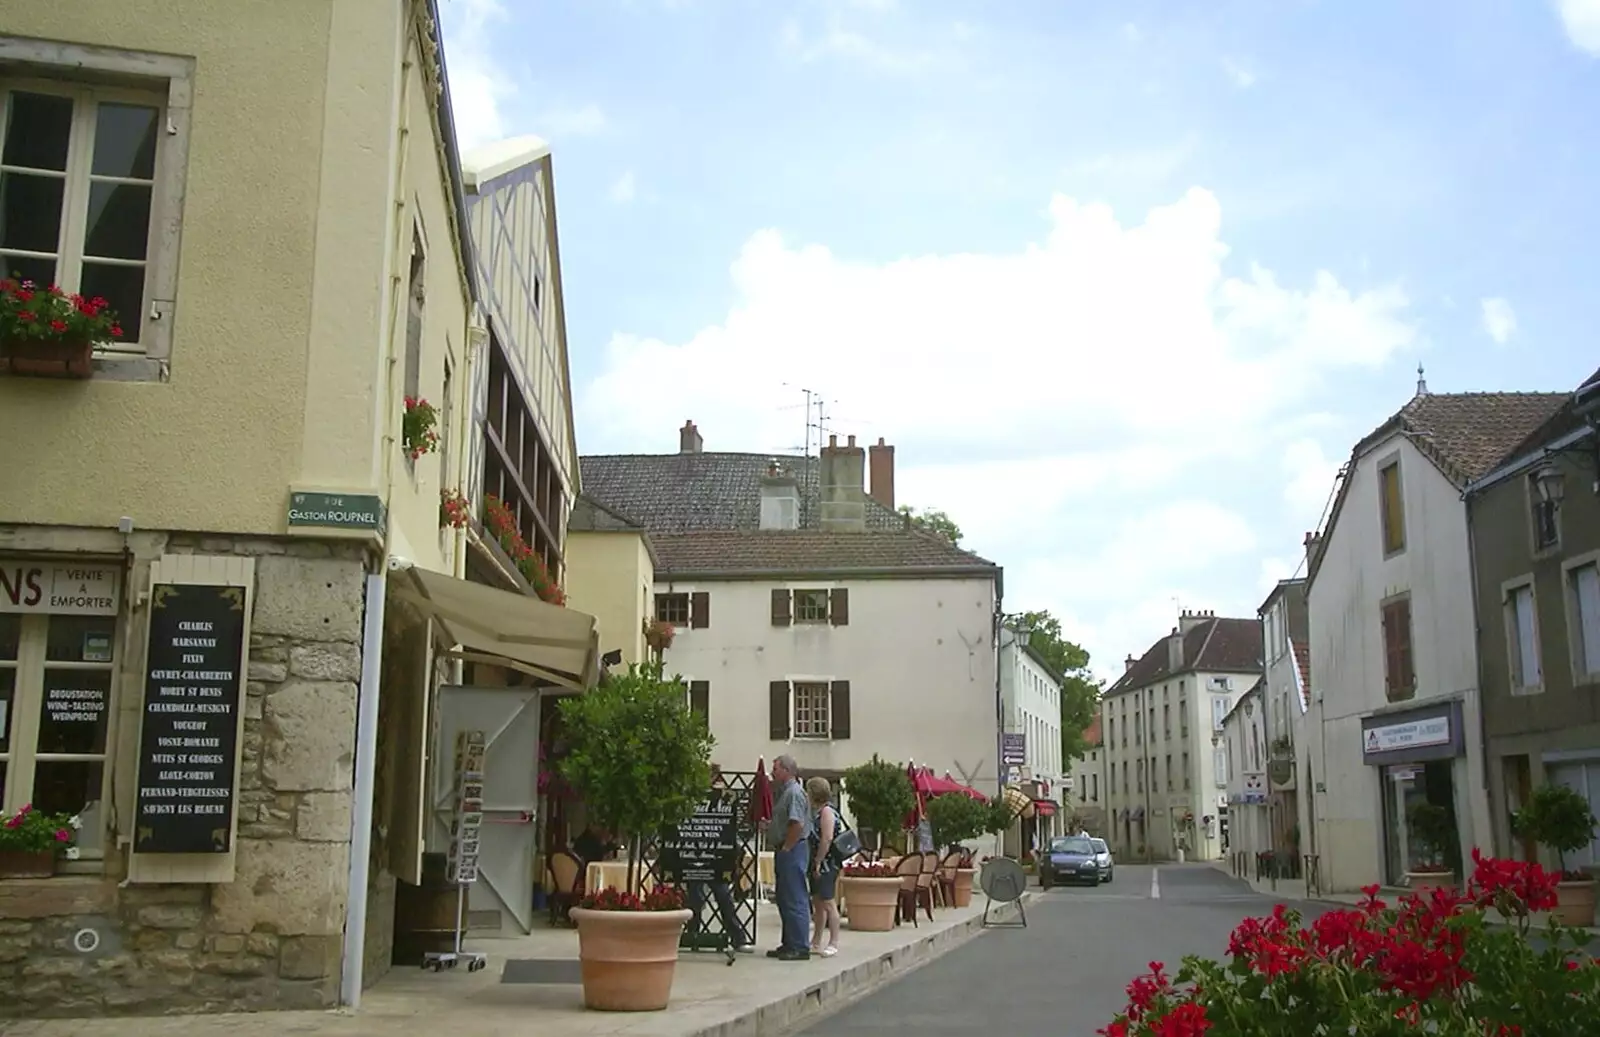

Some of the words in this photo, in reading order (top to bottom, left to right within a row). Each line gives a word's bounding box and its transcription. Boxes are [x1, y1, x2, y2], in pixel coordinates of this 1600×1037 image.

[288, 509, 327, 521] GASTON
[327, 511, 376, 523] ROUPNEL
[66, 569, 104, 580] VENTE
[51, 596, 114, 608] EMPORTER
[178, 621, 214, 632] CHABLIS
[171, 637, 217, 648] MARSANNAY
[151, 669, 233, 681] GEVREY-CHAMBERTIN
[148, 702, 232, 714] CHAMBOLLE-MUSIGNY
[172, 720, 207, 731] VOUGEOT
[188, 754, 224, 765] GEORGES
